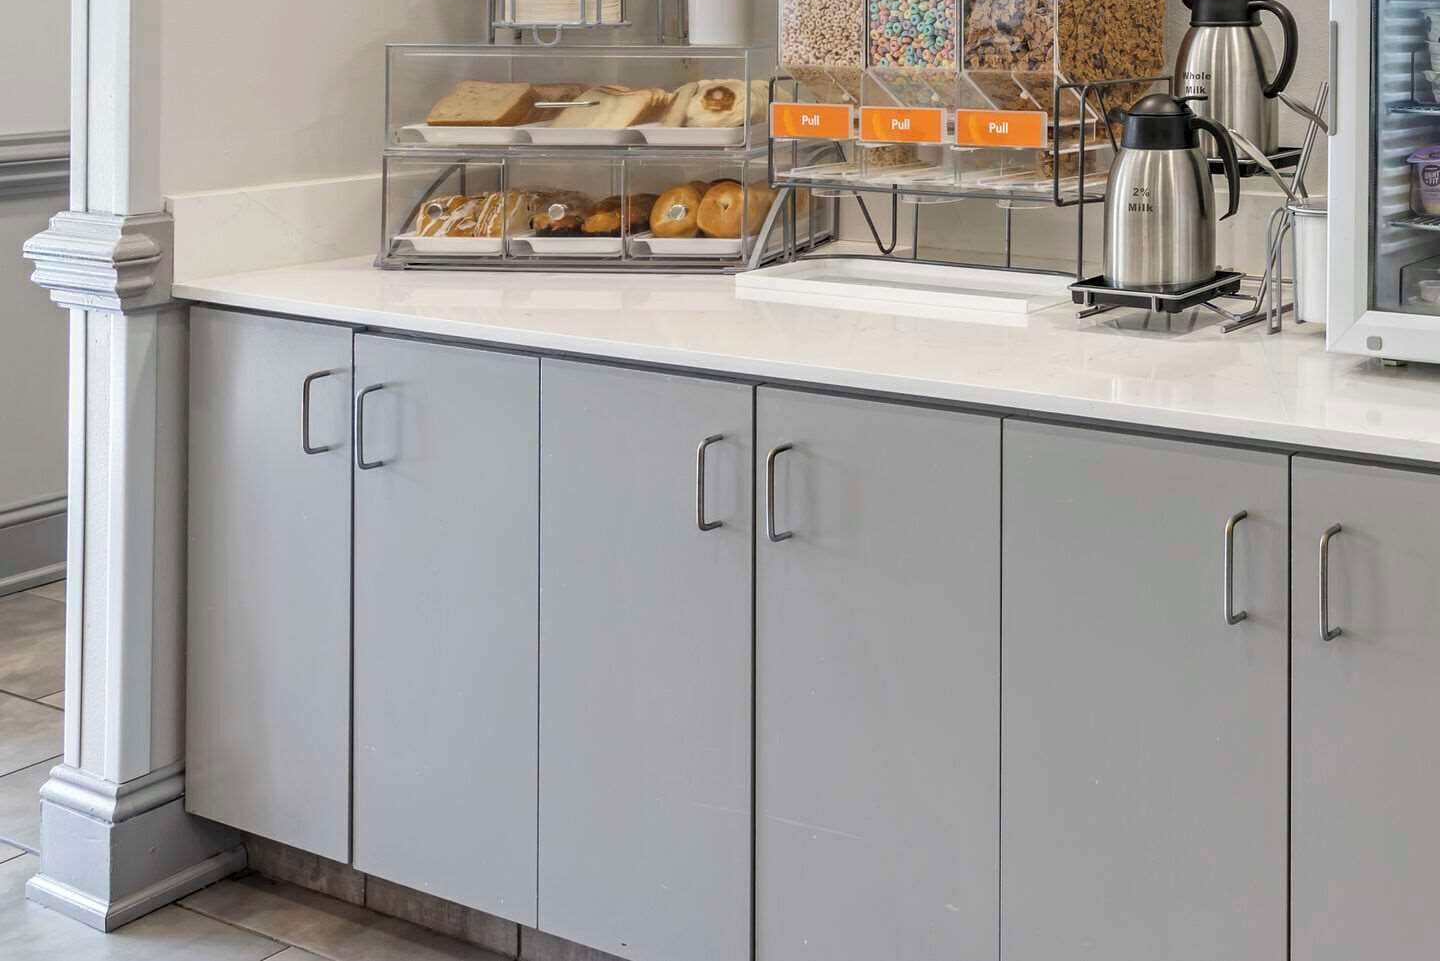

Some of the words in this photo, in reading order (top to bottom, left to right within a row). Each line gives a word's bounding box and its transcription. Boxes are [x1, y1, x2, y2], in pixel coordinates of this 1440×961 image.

[1183, 71, 1212, 80] Whole
[1185, 86, 1206, 94] Milk
[801, 115, 820, 127] Pull
[891, 119, 911, 131] Pull
[988, 122, 1009, 135] Pull
[1132, 187, 1151, 197] 2%
[1128, 203, 1153, 212] Milk
